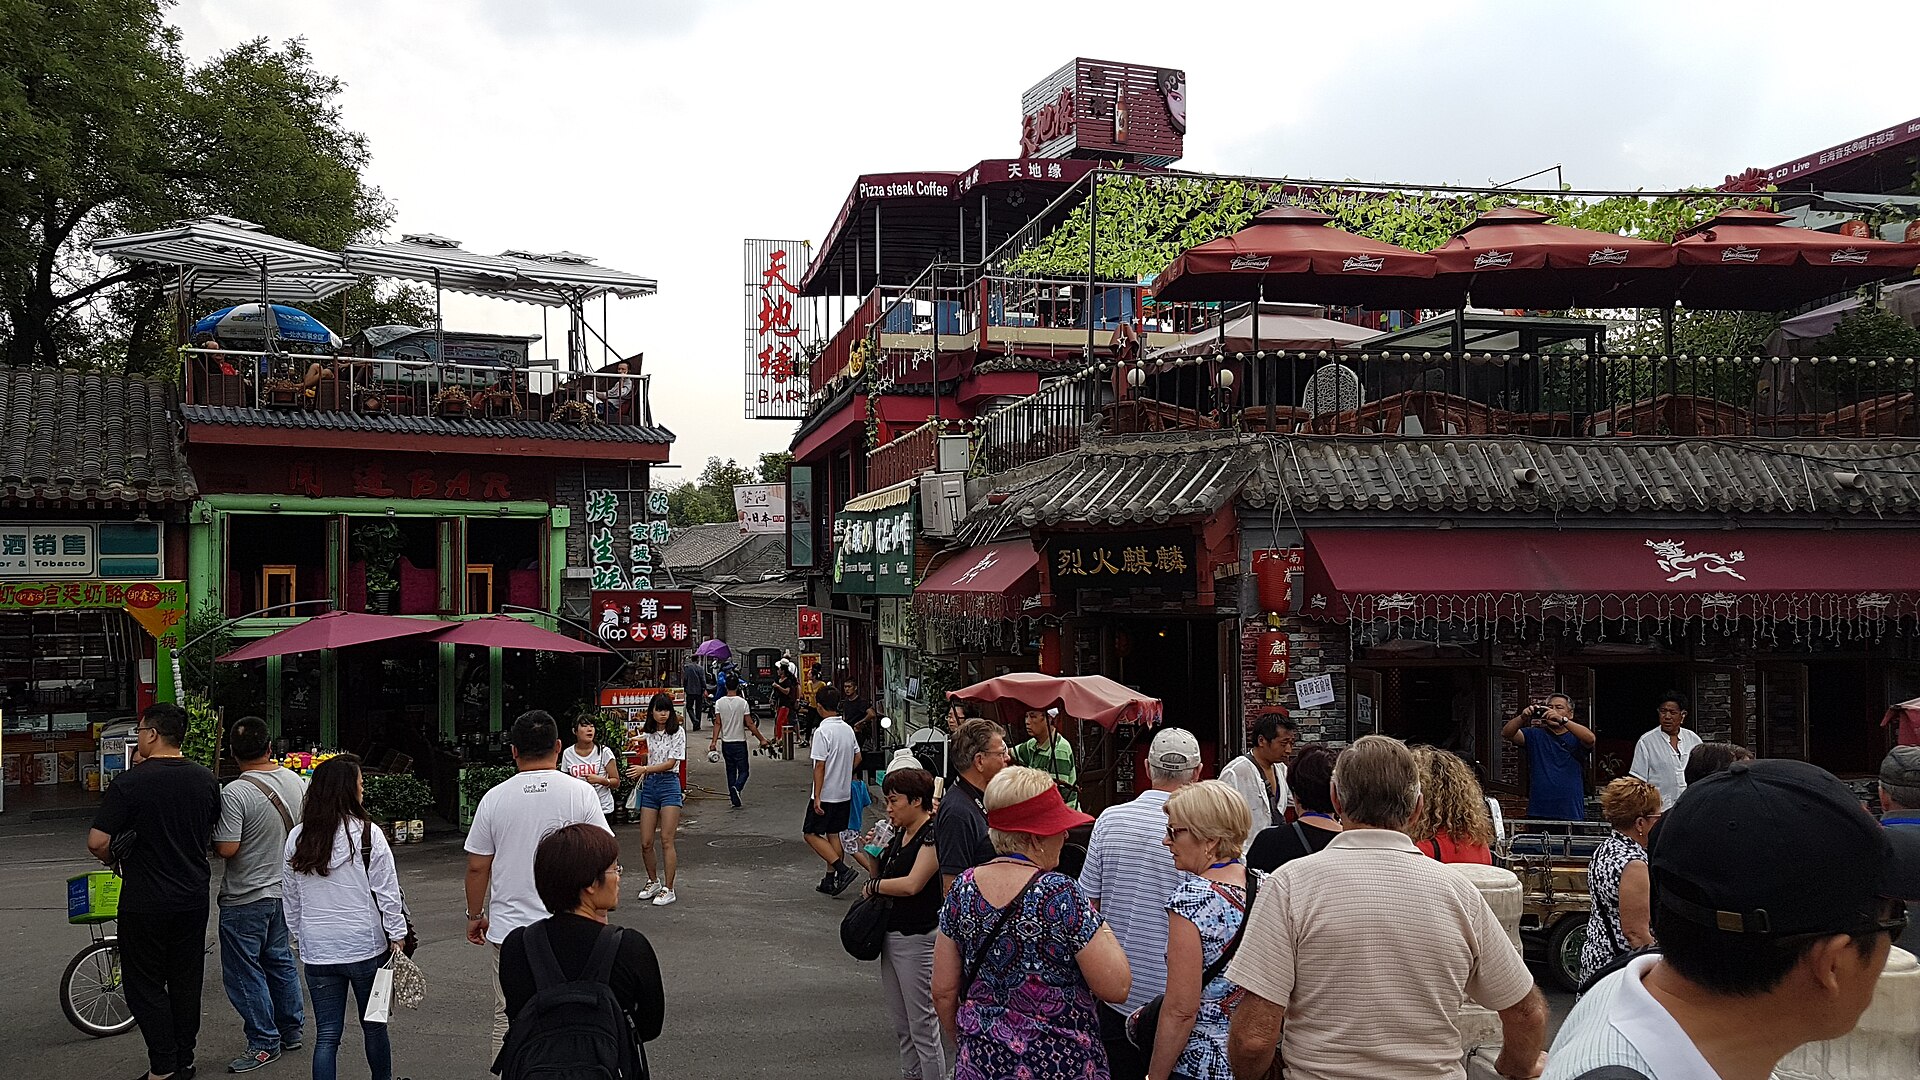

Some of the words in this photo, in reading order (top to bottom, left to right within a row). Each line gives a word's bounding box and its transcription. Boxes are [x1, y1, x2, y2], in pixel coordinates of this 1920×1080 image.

[1008, 163, 1062, 179] 天地缘
[1776, 168, 1789, 178] CD
[1792, 162, 1811, 174] Live
[859, 182, 885, 198] Pizza
[887, 181, 914, 196] steak
[916, 180, 948, 196] Coffee
[1230, 256, 1270, 269] Budweiser
[1342, 259, 1382, 271] Budweiser
[1474, 255, 1513, 268] Budweiser
[1588, 251, 1627, 264] Budweiser
[758, 389, 801, 403] BAR
[407, 471, 511, 498] BAR
[649, 491, 670, 544] 饮料
[1058, 545, 1187, 576] 烈火麒麟
[640, 599, 682, 619] 第一
[160, 587, 178, 649] 棉花糖
[802, 614, 818, 622] 日式
[632, 624, 687, 640] 大鸡排
